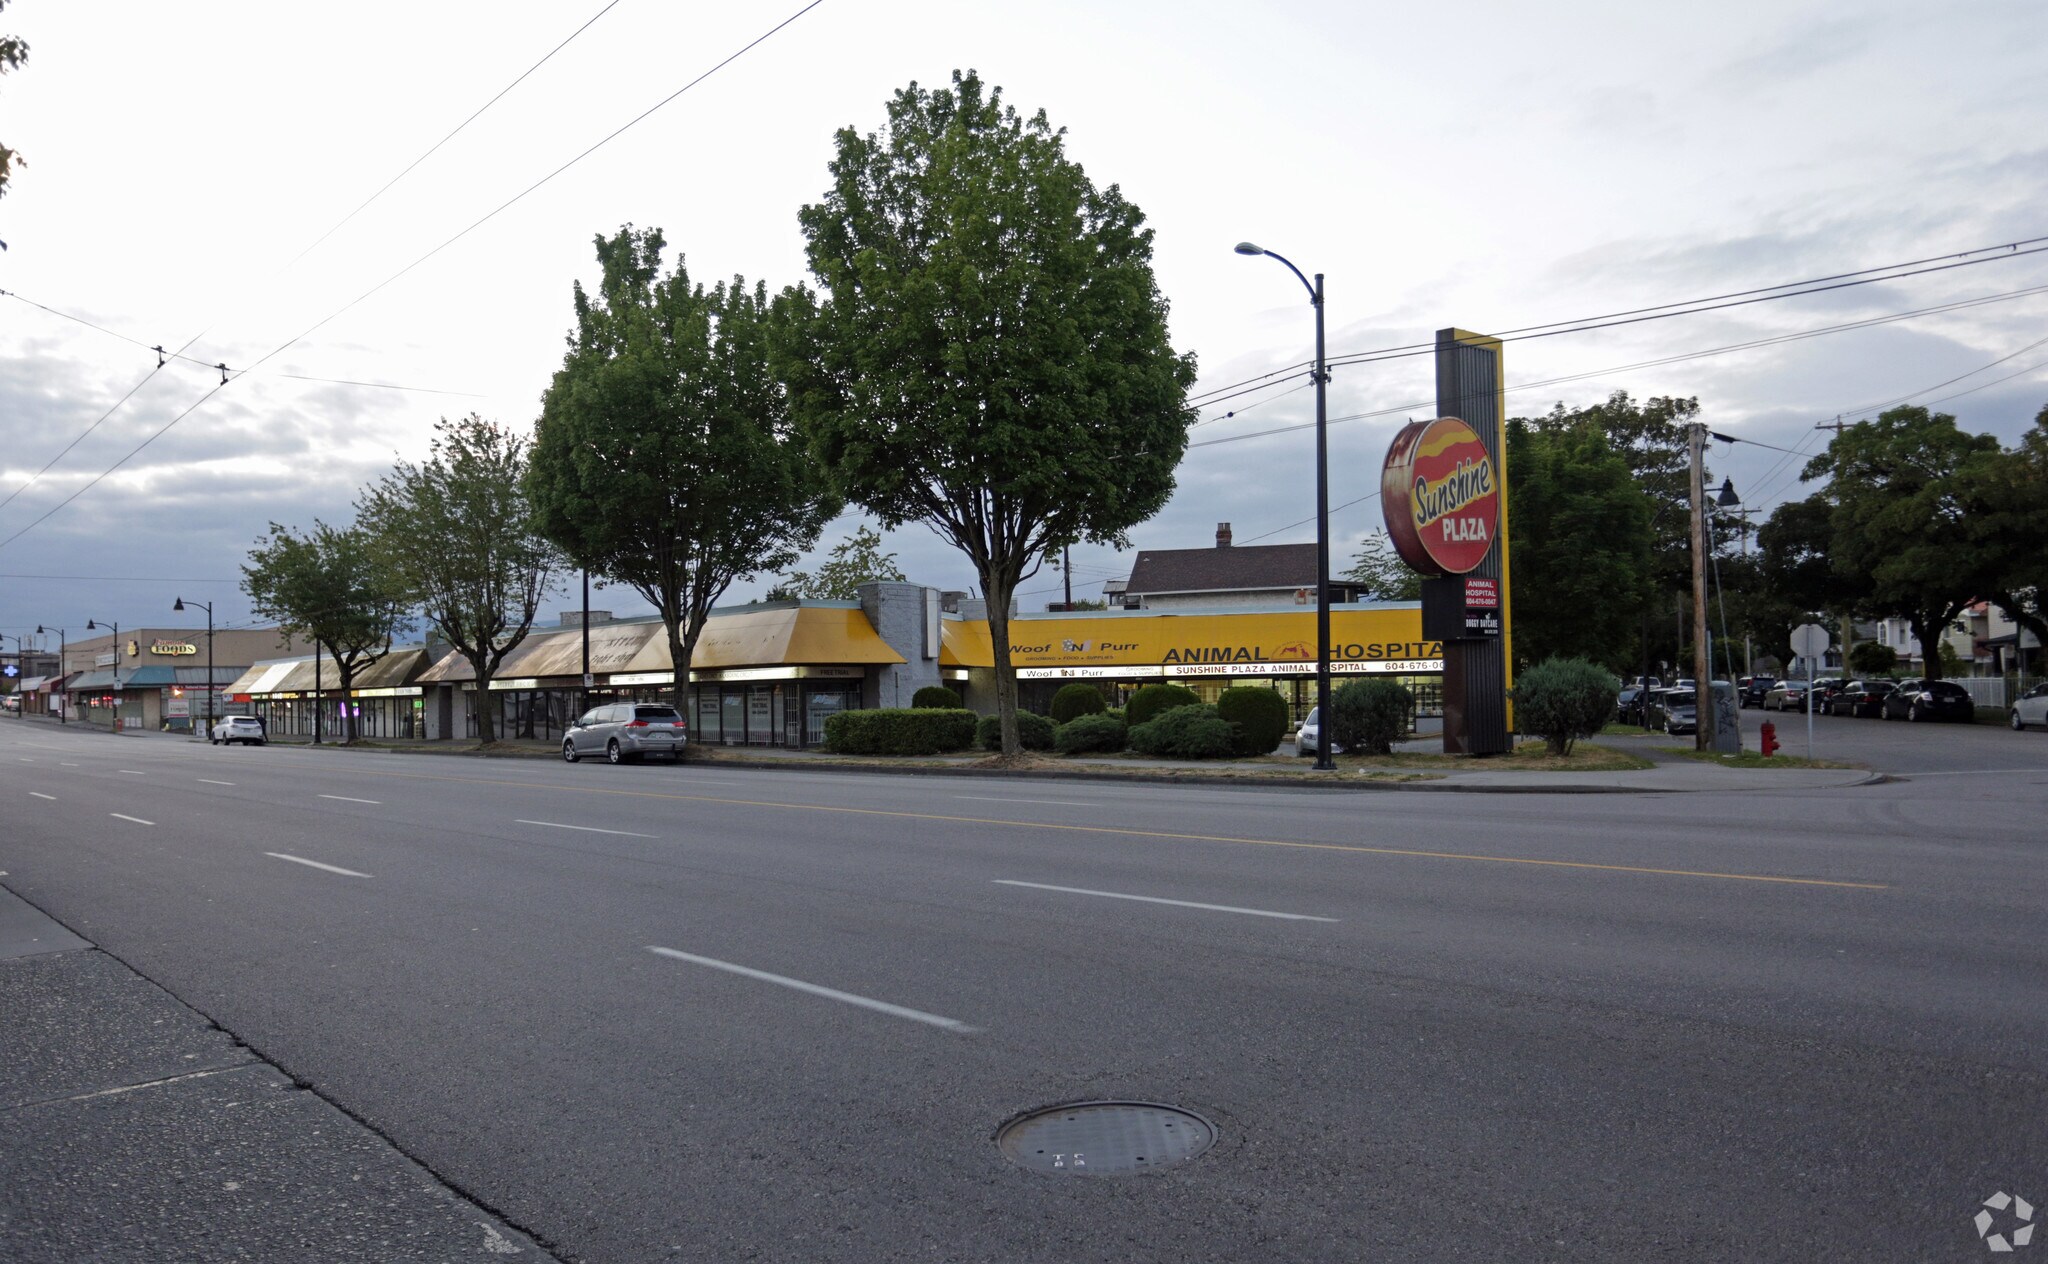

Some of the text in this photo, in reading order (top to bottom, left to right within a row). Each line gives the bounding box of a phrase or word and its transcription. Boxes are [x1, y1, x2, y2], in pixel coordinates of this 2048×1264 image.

[1415, 458, 1491, 525] Sunshine
[1442, 518, 1487, 541] PLAZA
[1467, 580, 1494, 588] ANIMAL
[1465, 589, 1496, 597] HOSPITAL
[155, 645, 193, 653] FOODS
[1008, 644, 1052, 654] Woof
[1100, 643, 1140, 652] Purr
[1162, 646, 1269, 663] ANIMAL
[1329, 642, 1443, 659] HOSPITA
[1082, 669, 1104, 677] Purr
[1176, 661, 1443, 674] SUNSHINE PLAZA ANIMAL SPITAL 604-676-00
